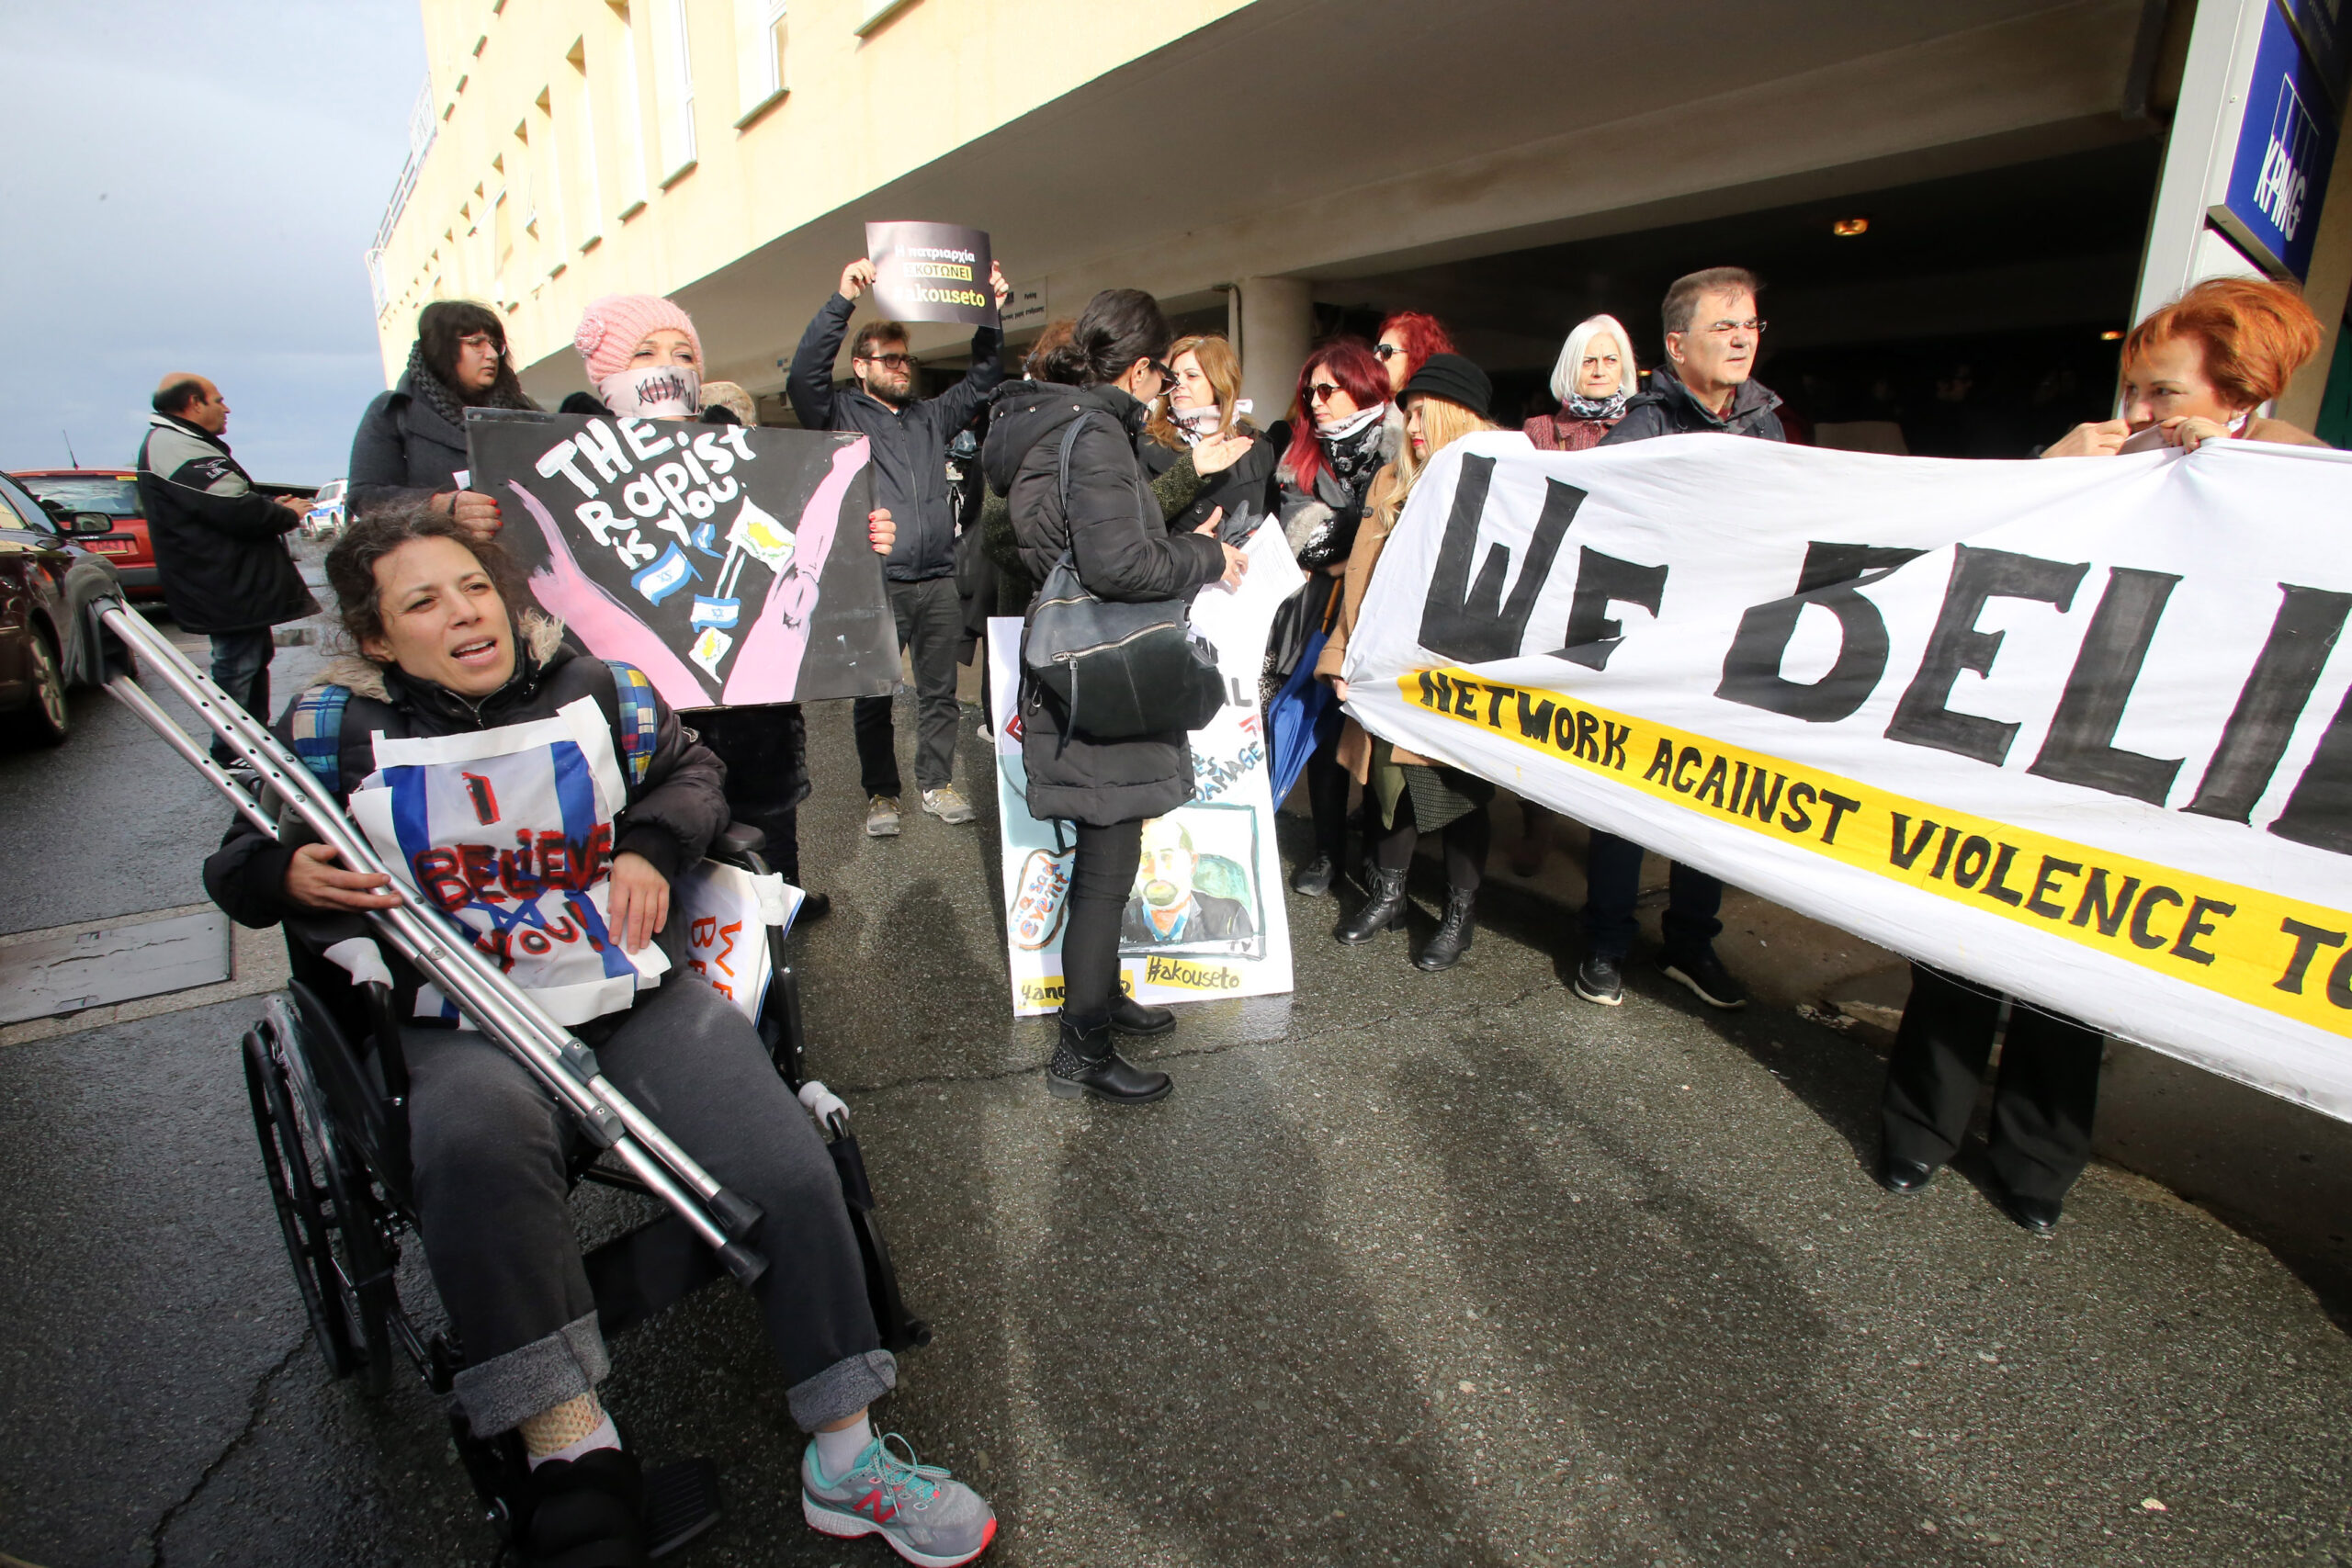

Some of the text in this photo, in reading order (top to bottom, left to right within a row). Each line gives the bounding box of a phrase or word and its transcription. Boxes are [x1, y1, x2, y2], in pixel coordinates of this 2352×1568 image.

[2254, 135, 2307, 242] KPMG
[535, 417, 675, 499] THE
[1418, 452, 1669, 671] WE
[1419, 671, 1632, 771] NETWORK
[1643, 739, 1860, 845] AGAINST
[1890, 811, 2236, 966] VIOLENCE
[1148, 955, 1240, 990] #akouseto
